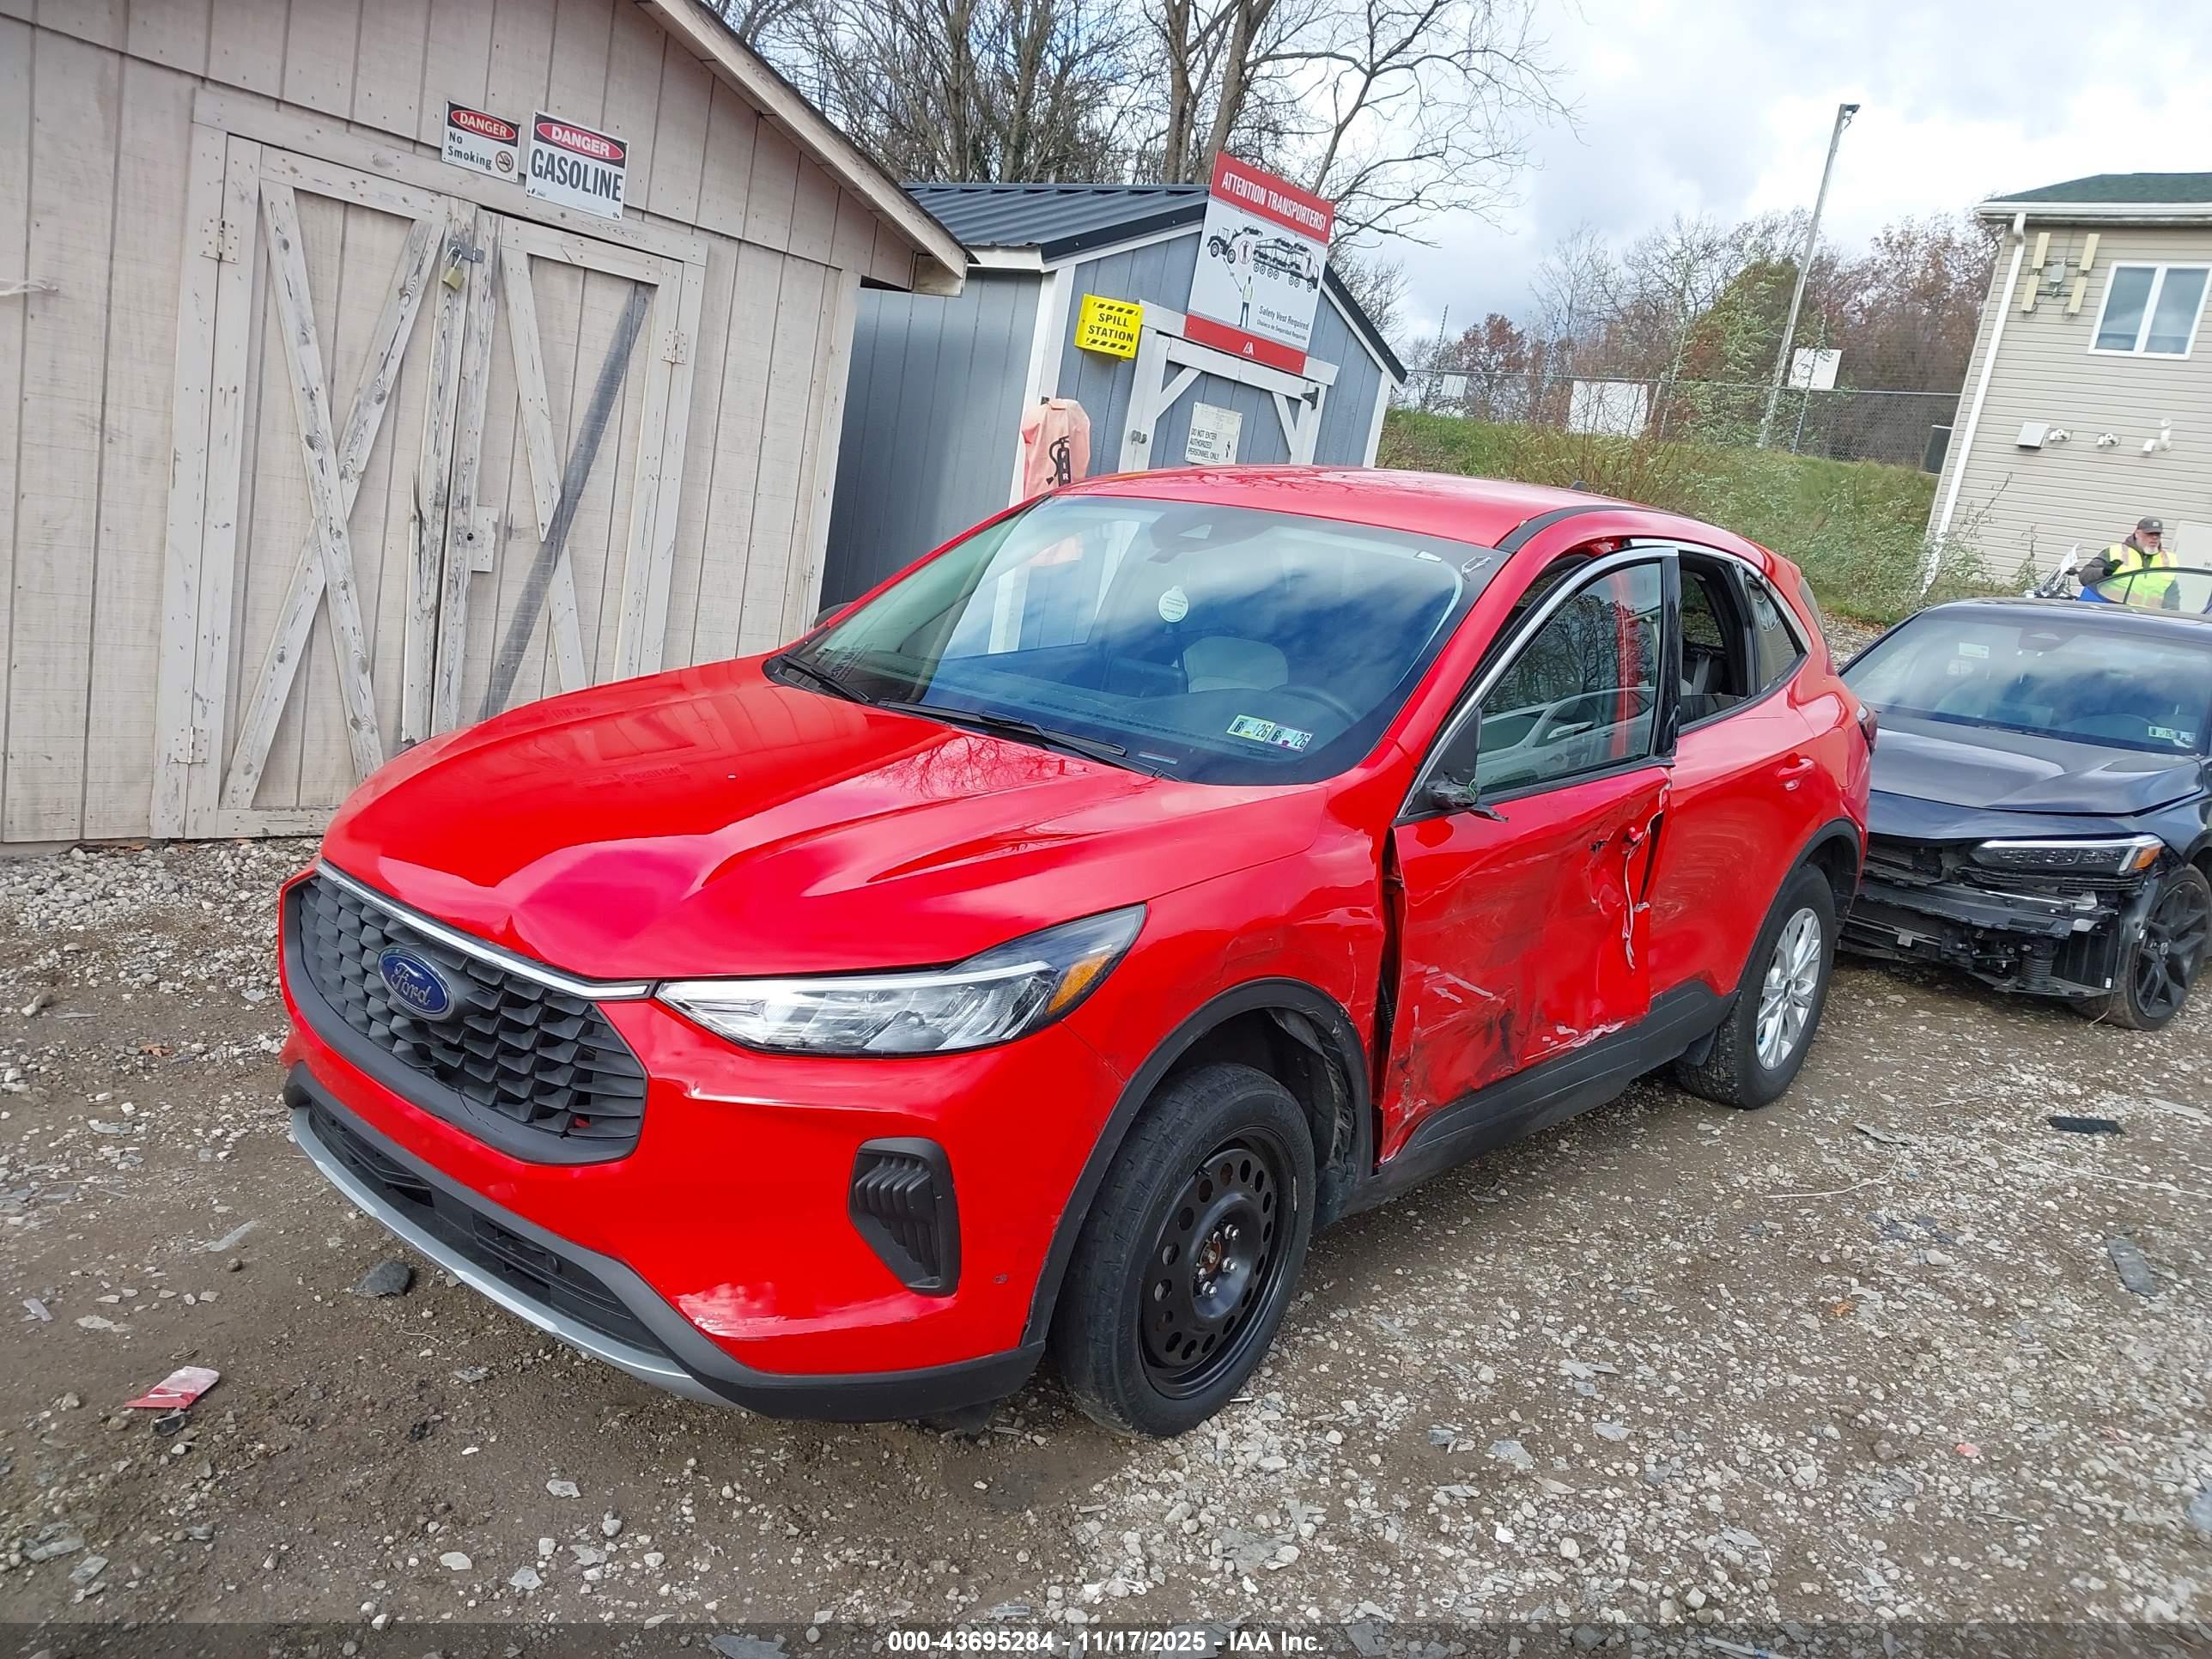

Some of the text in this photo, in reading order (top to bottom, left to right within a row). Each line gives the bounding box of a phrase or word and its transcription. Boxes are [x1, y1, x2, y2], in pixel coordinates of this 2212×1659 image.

[459, 112, 507, 138] DANGER
[449, 131, 463, 145] No
[551, 125, 610, 158] DANGER
[447, 146, 492, 171] Smoking
[531, 149, 623, 203] GASOLINE
[1221, 171, 1327, 232] ATTENTION TRANSPORTERS!
[1097, 313, 1129, 328] SPILL
[1259, 305, 1310, 331] Safety Vest Required
[1087, 325, 1134, 343] STATION
[1234, 721, 1244, 733] 6
[1271, 730, 1281, 742] 6
[391, 962, 432, 1006] Ford
